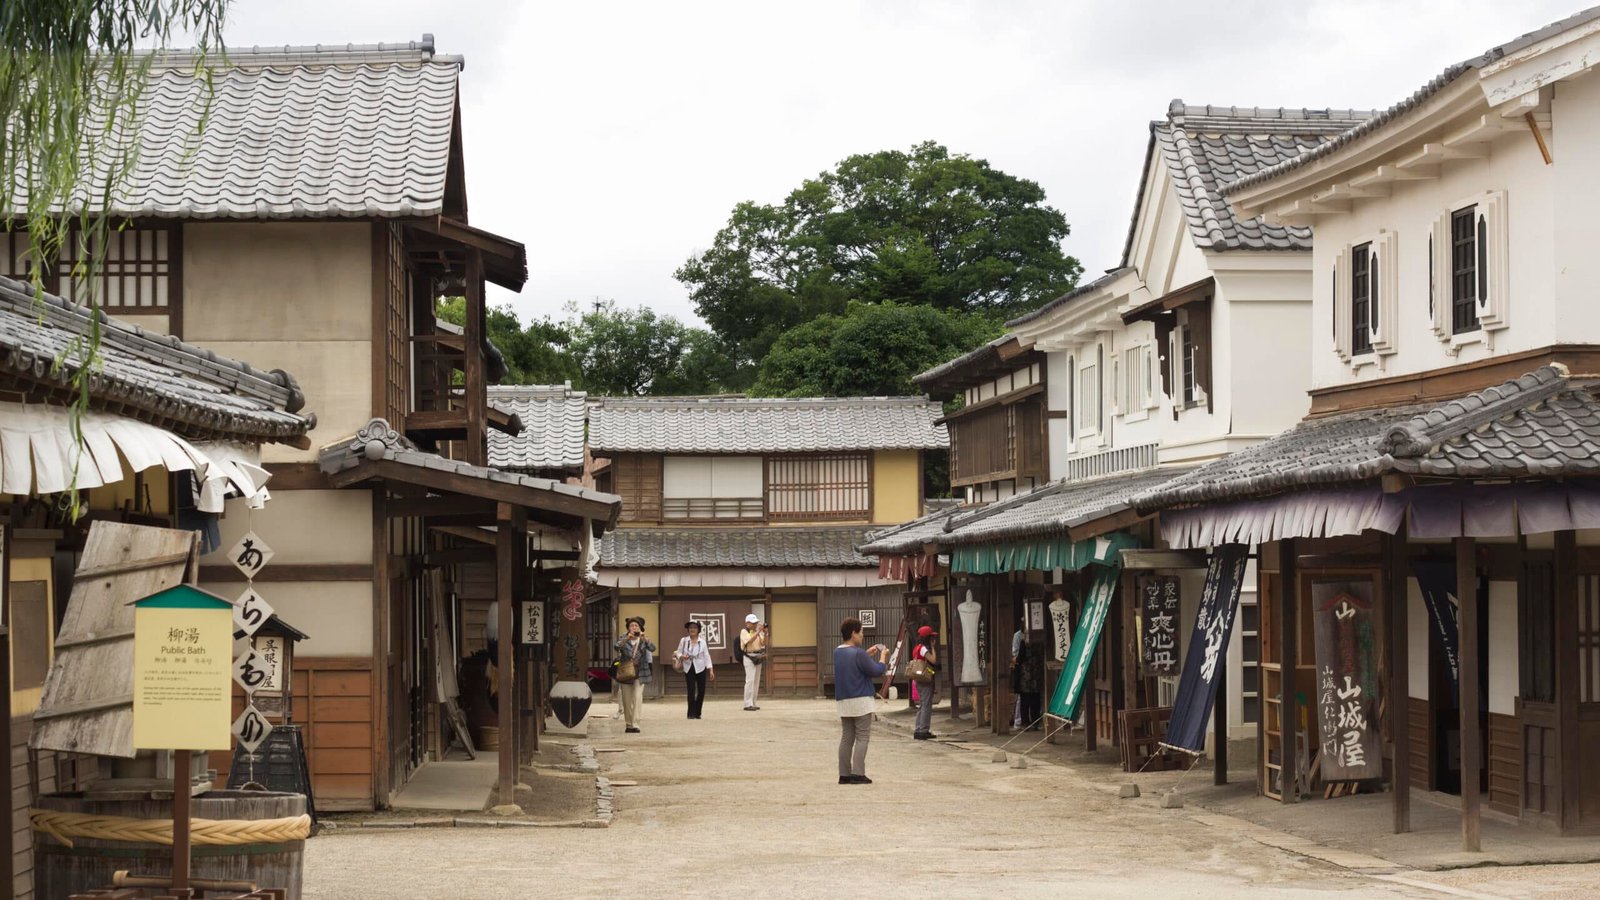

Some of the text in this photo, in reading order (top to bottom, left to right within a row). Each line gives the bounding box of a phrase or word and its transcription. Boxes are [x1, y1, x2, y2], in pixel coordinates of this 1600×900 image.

[1335, 602, 1356, 620] 山
[527, 605, 541, 642] 松見堂
[168, 627, 200, 644] 柳湯
[161, 646, 206, 655] Public Bath
[1336, 676, 1367, 768] 山城屋
